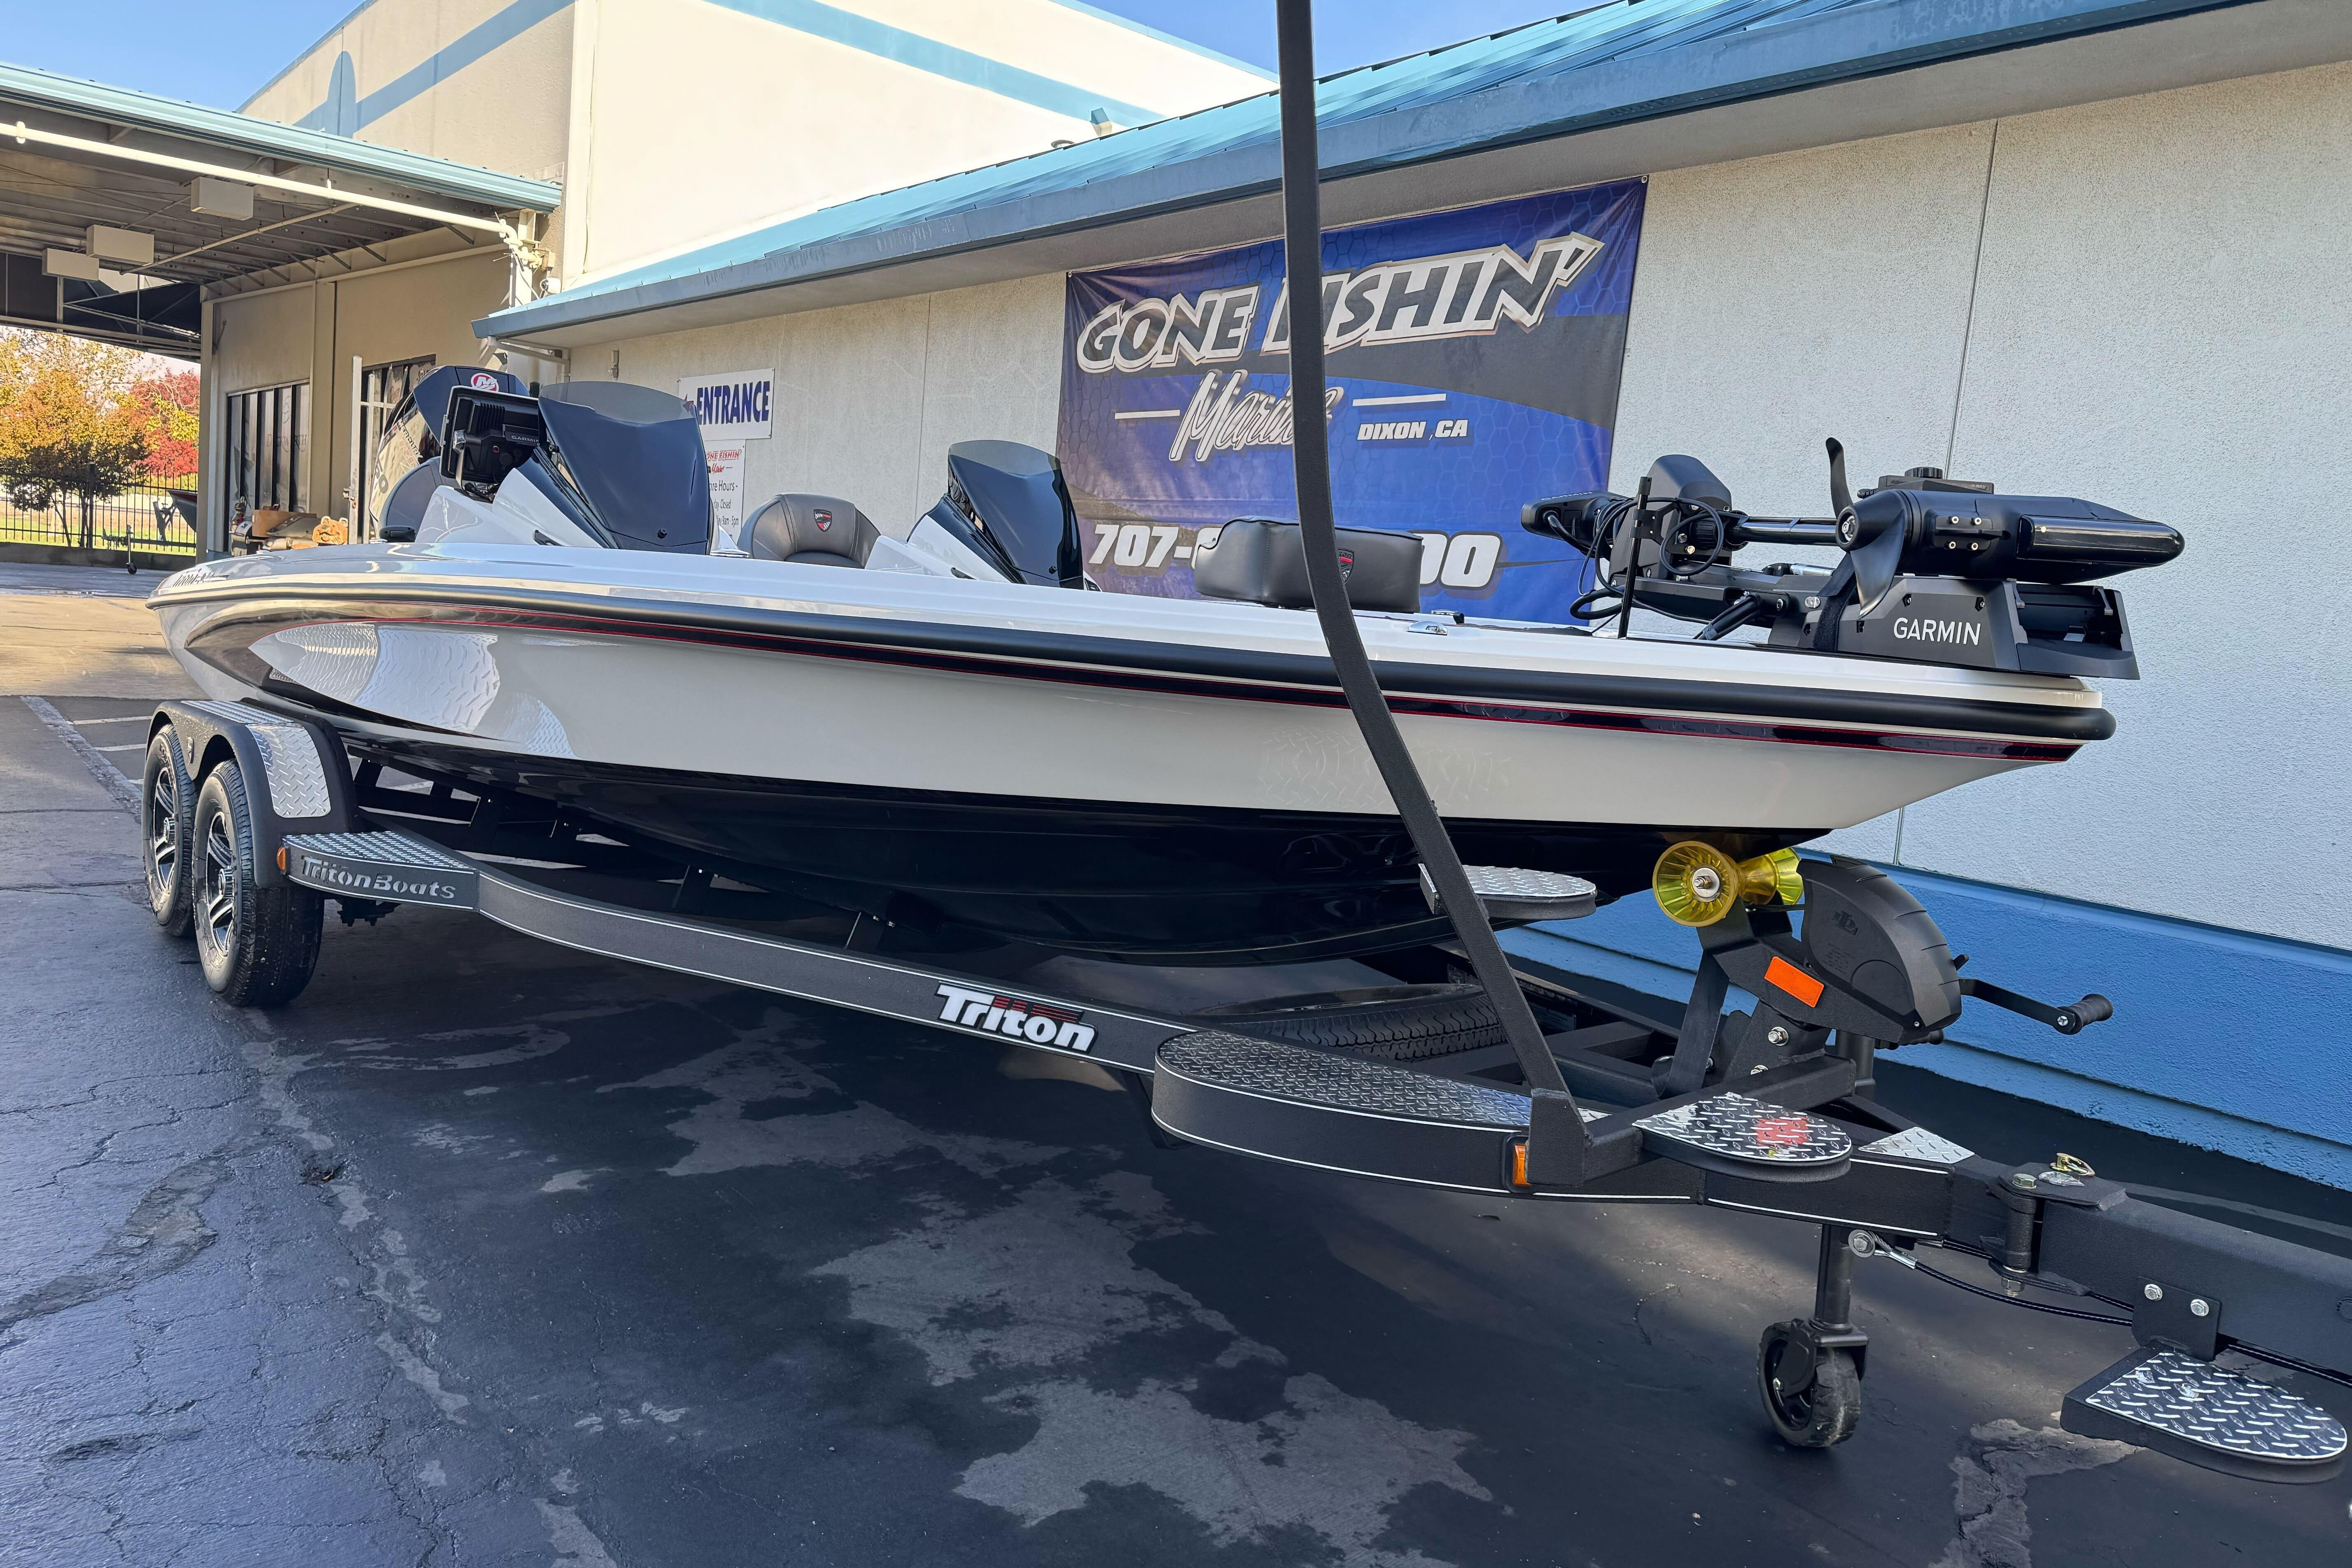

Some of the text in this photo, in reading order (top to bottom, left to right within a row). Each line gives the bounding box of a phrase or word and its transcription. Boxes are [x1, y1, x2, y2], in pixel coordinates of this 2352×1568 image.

[1077, 286, 1259, 373] GONE
[697, 381, 770, 425] ENTRANCE
[1357, 422, 1426, 440] DIXON
[719, 480, 735, 491] Hours
[1894, 617, 1981, 646] GARMIN
[936, 984, 1096, 1052] Triton
